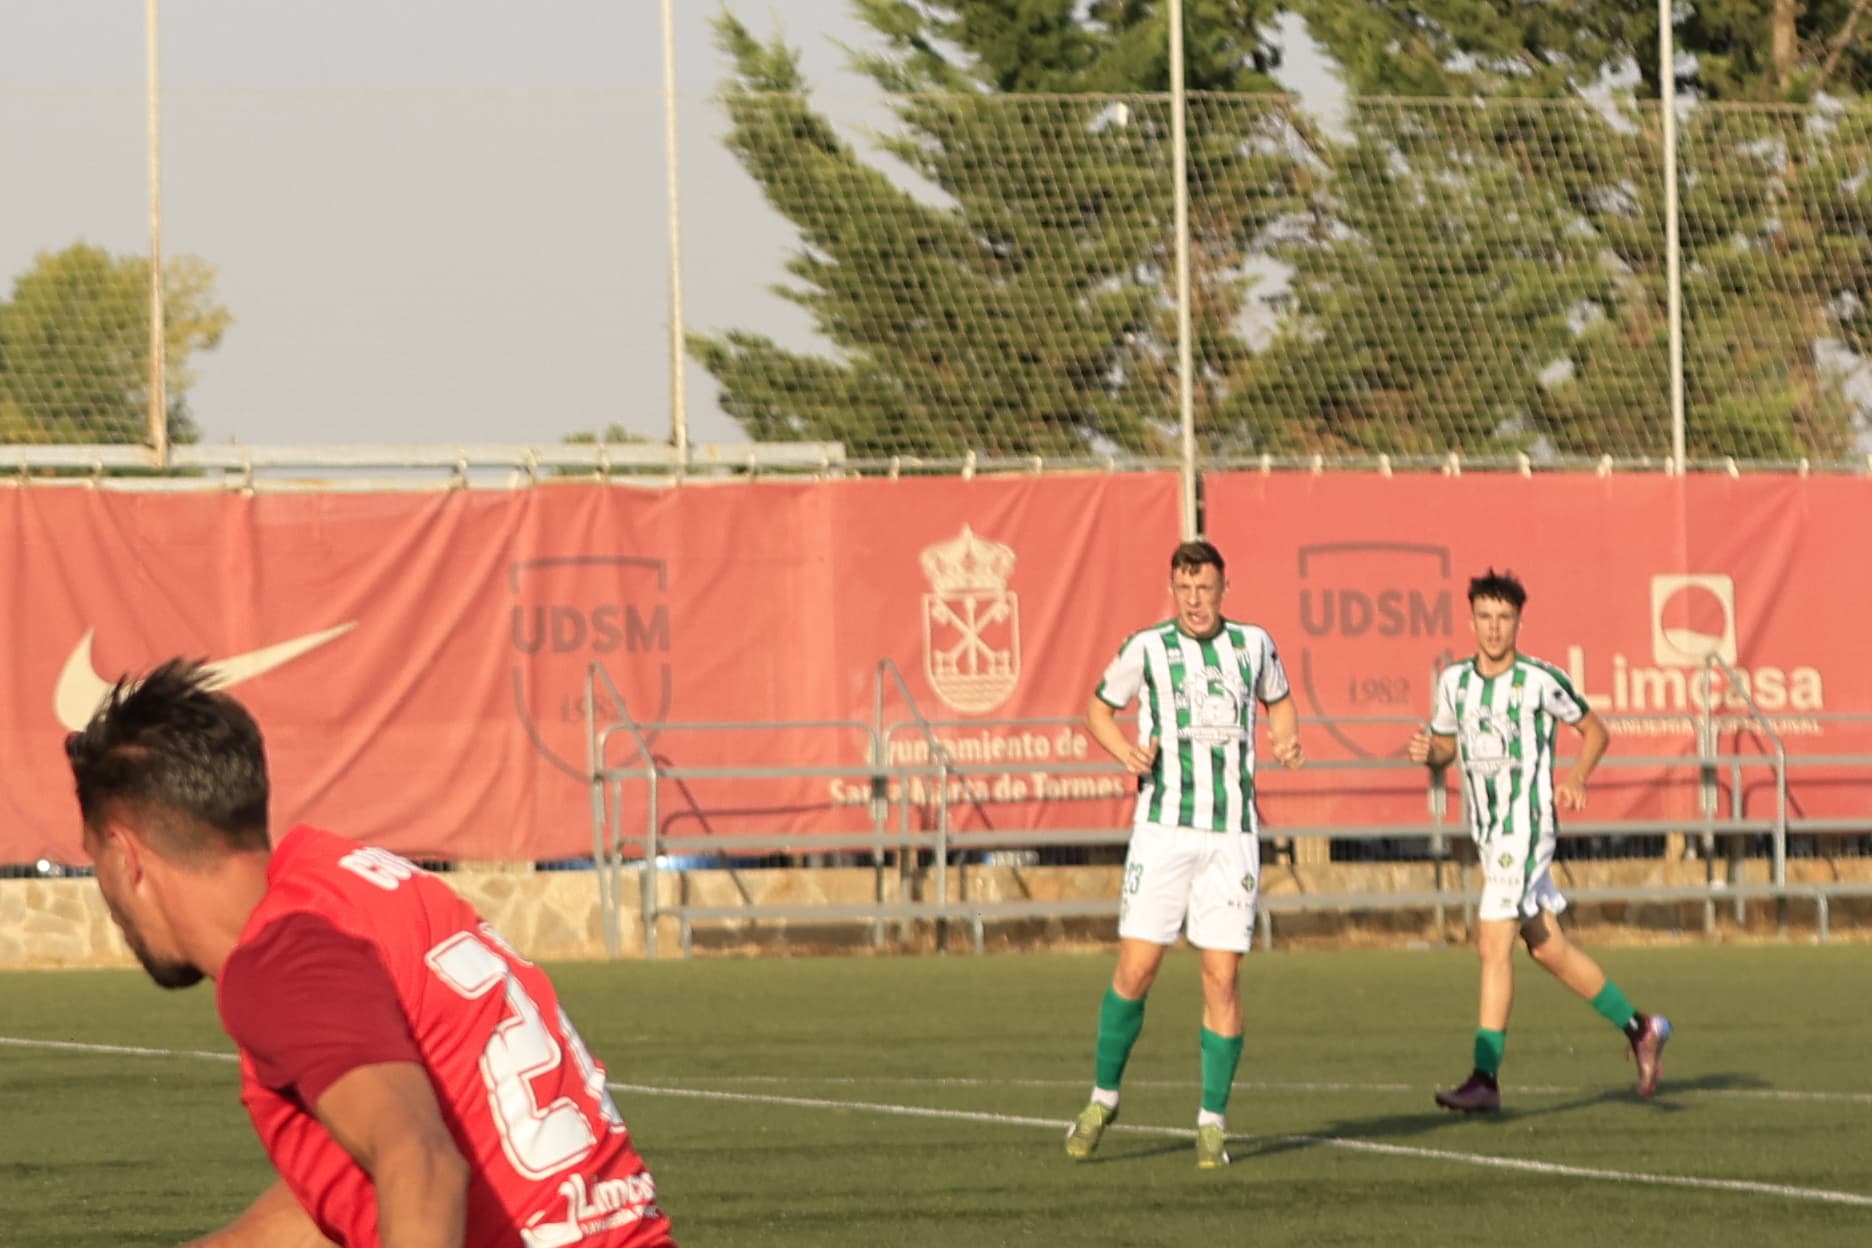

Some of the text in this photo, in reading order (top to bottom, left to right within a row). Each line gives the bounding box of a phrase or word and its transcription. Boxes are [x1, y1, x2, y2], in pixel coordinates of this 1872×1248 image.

[511, 603, 671, 655] UDSM
[1299, 588, 1453, 637] UDSM
[1567, 644, 1824, 711] Limcasa
[1056, 727, 1089, 759] de
[994, 772, 1028, 801] de
[1032, 770, 1127, 798] Tormes
